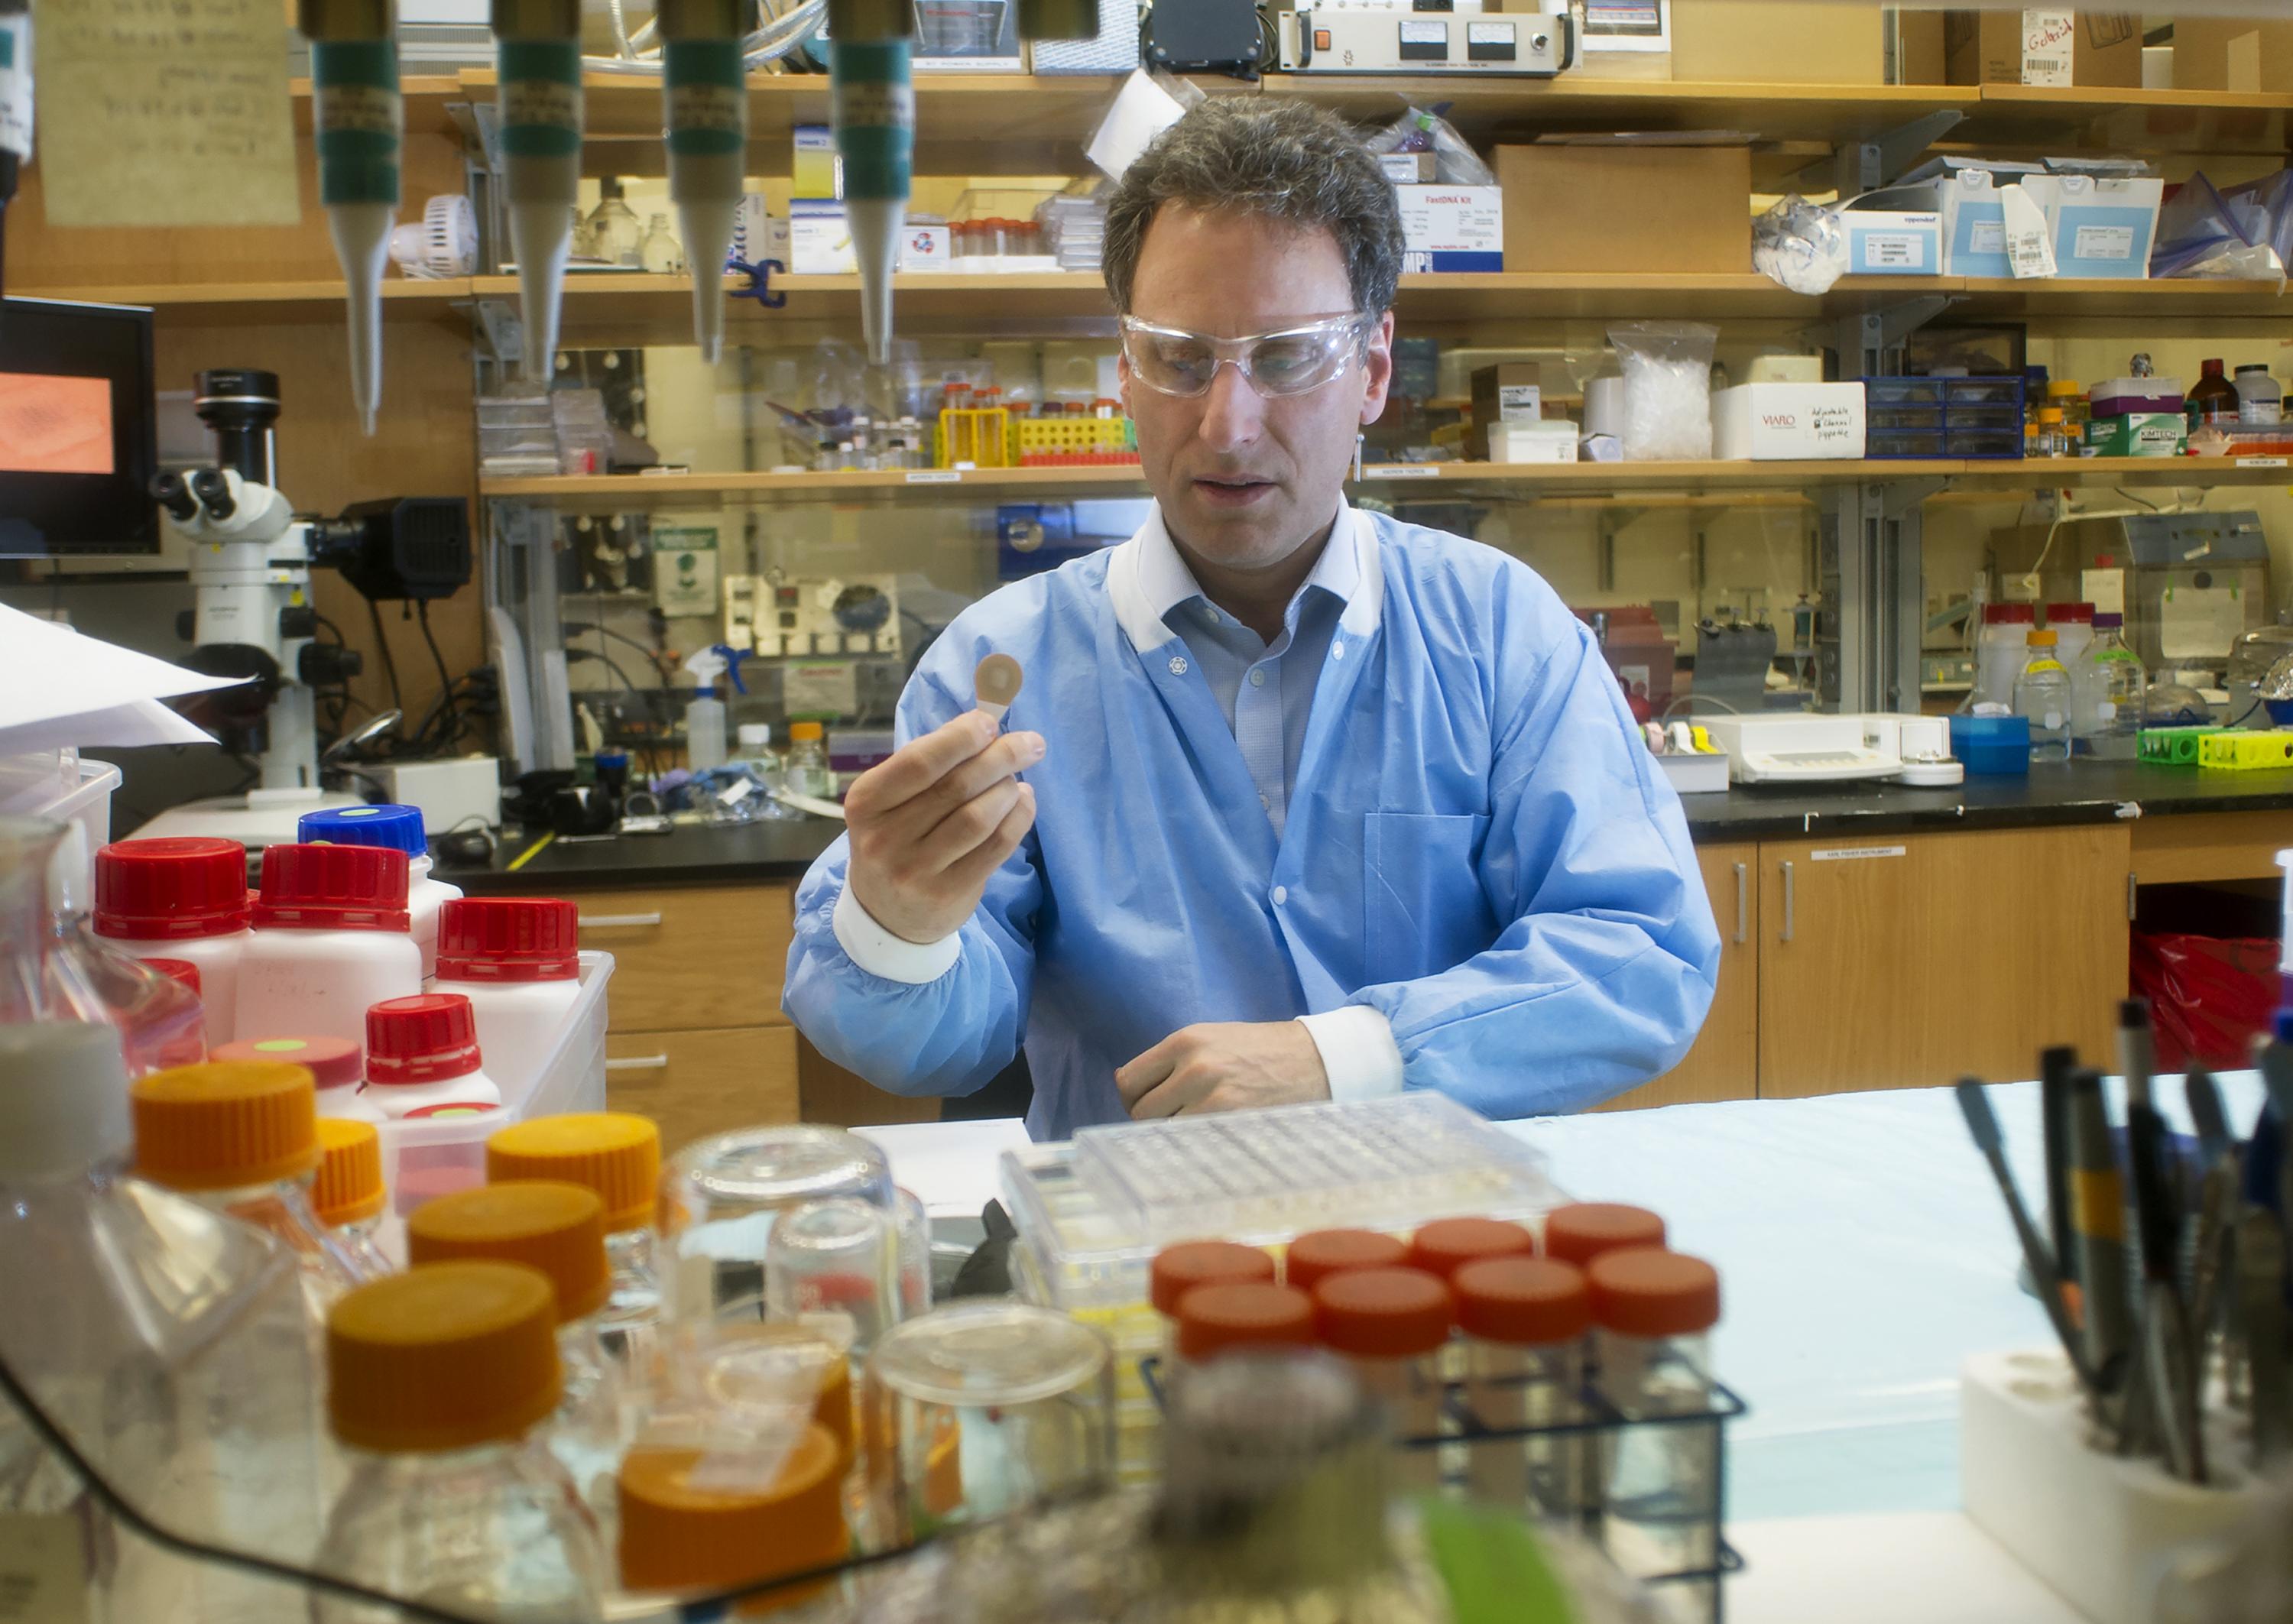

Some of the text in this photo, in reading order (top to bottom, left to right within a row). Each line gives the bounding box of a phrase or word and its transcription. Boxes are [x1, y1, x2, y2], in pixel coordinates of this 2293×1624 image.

[1425, 196, 1472, 205] FastDNA Kit
[2141, 430, 2177, 438] KIMTECH
